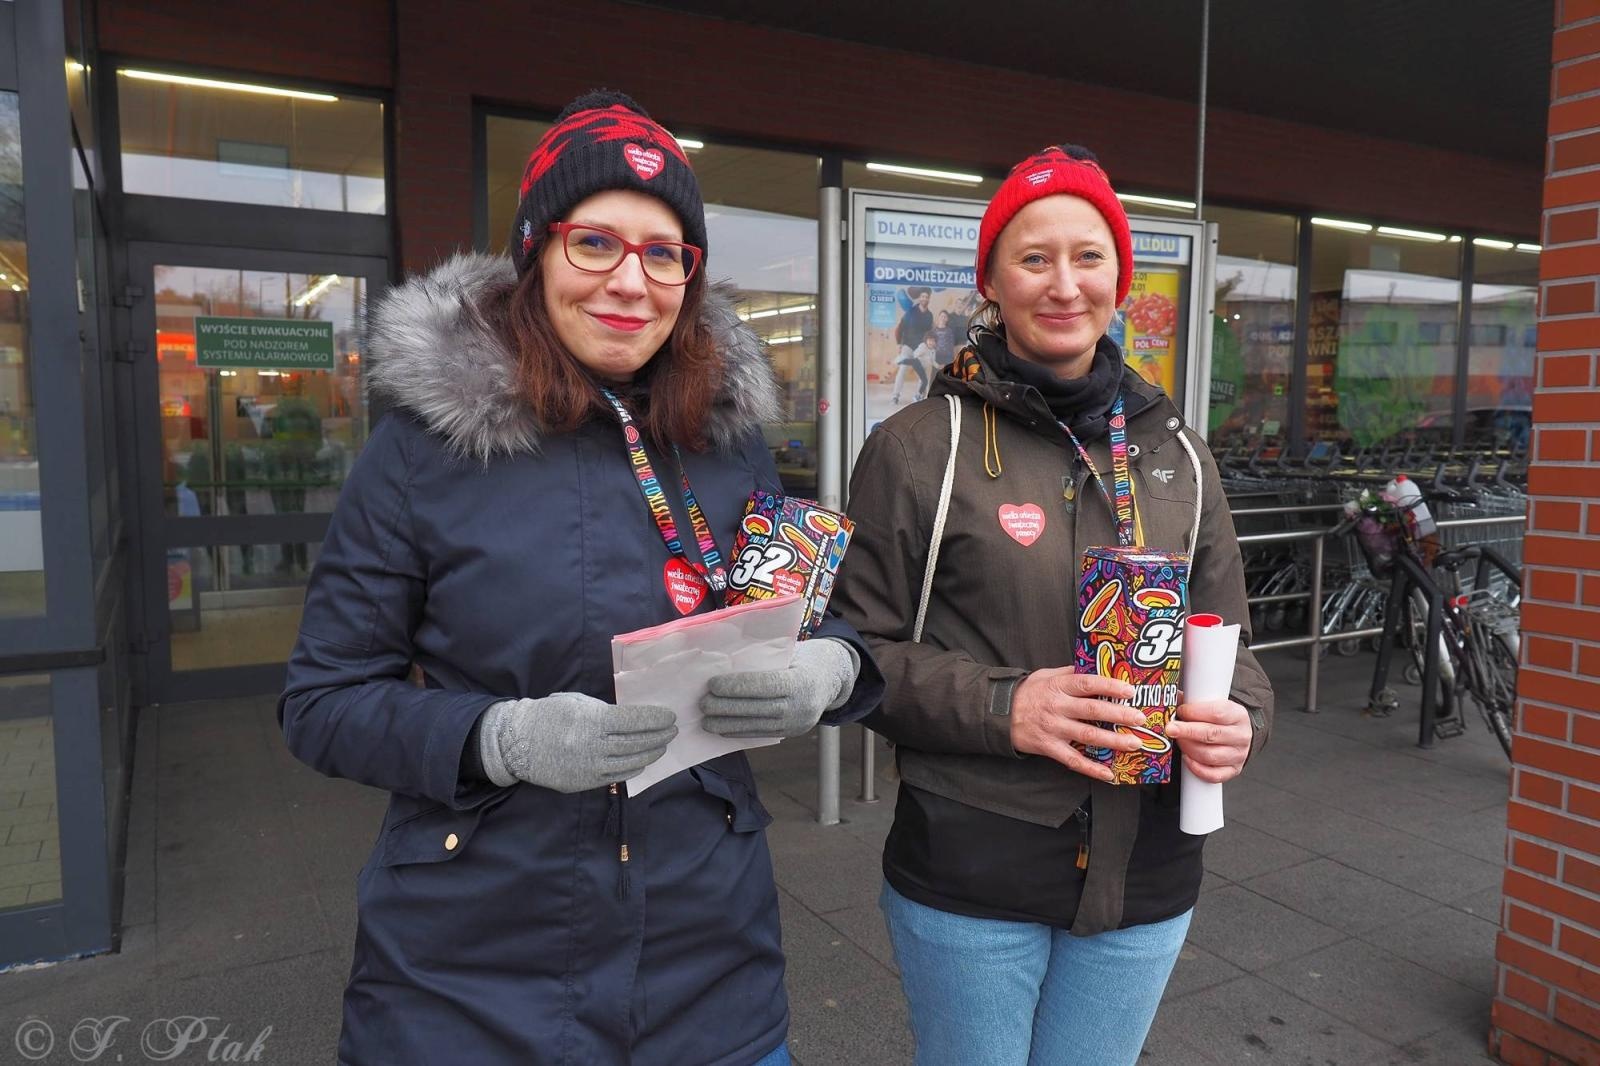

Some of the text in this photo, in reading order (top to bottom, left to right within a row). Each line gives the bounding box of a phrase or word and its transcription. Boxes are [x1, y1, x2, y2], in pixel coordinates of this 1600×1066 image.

[877, 220, 906, 236] DLA
[909, 223, 963, 240] TAKICH
[1139, 238, 1176, 253] LIDLU
[874, 267, 895, 280] OD
[200, 323, 329, 338] WYJŚCIE EWAKUACYJNE
[223, 339, 309, 351] POD NADZOREM
[203, 350, 329, 362] SYSTEMU ALARMOWEGO
[1111, 429, 1126, 442] TU
[636, 464, 658, 486] GRA
[1111, 444, 1130, 491] WSZYSTKO
[1115, 491, 1132, 509] GRA
[645, 486, 678, 542] WSZYSTKO
[686, 498, 716, 554] WSZYSTKO
[748, 534, 769, 545] 2024
[703, 551, 721, 569] TU
[730, 543, 794, 588] 32
[1148, 608, 1178, 618] 2024
[1113, 685, 1178, 707] YSTKO GR
